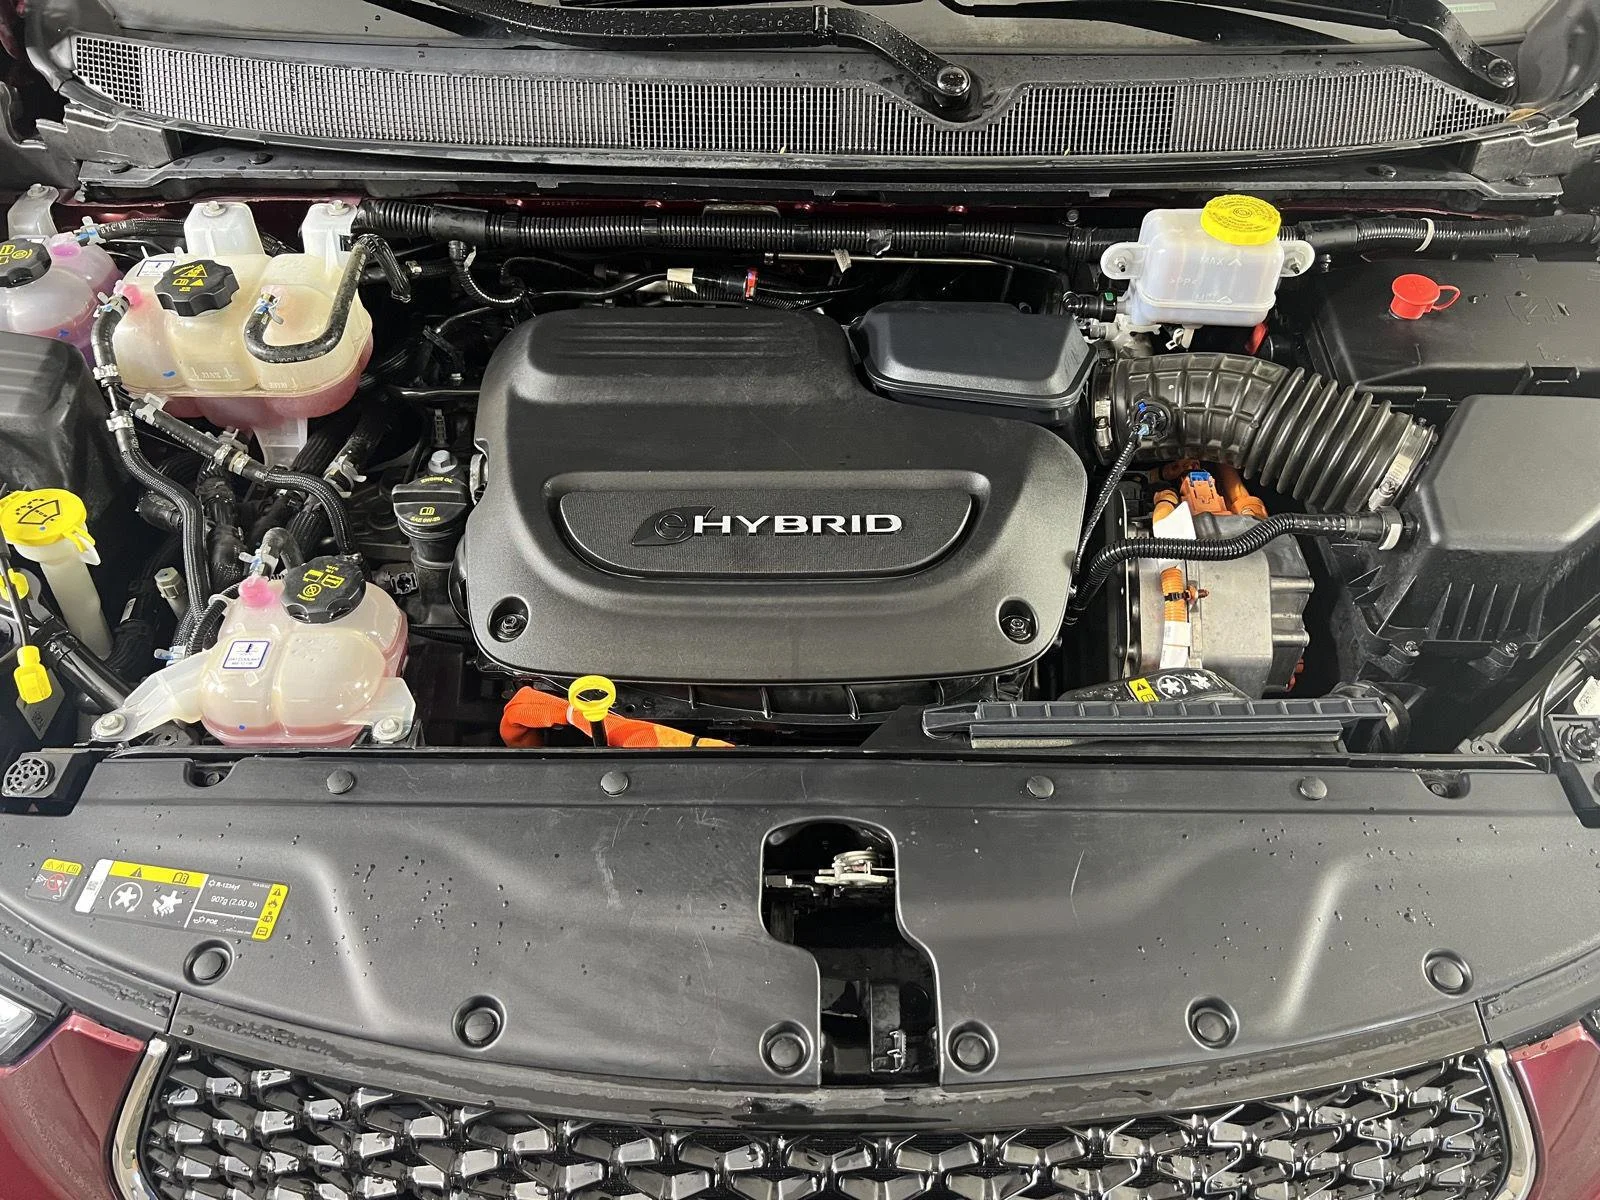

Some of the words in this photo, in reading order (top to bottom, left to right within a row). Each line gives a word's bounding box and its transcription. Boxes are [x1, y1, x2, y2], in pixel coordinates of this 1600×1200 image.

[694, 514, 903, 536] HYBRID
[211, 895, 228, 905] 907g
[229, 898, 247, 907] (2.00
[248, 901, 257, 909] lb)
